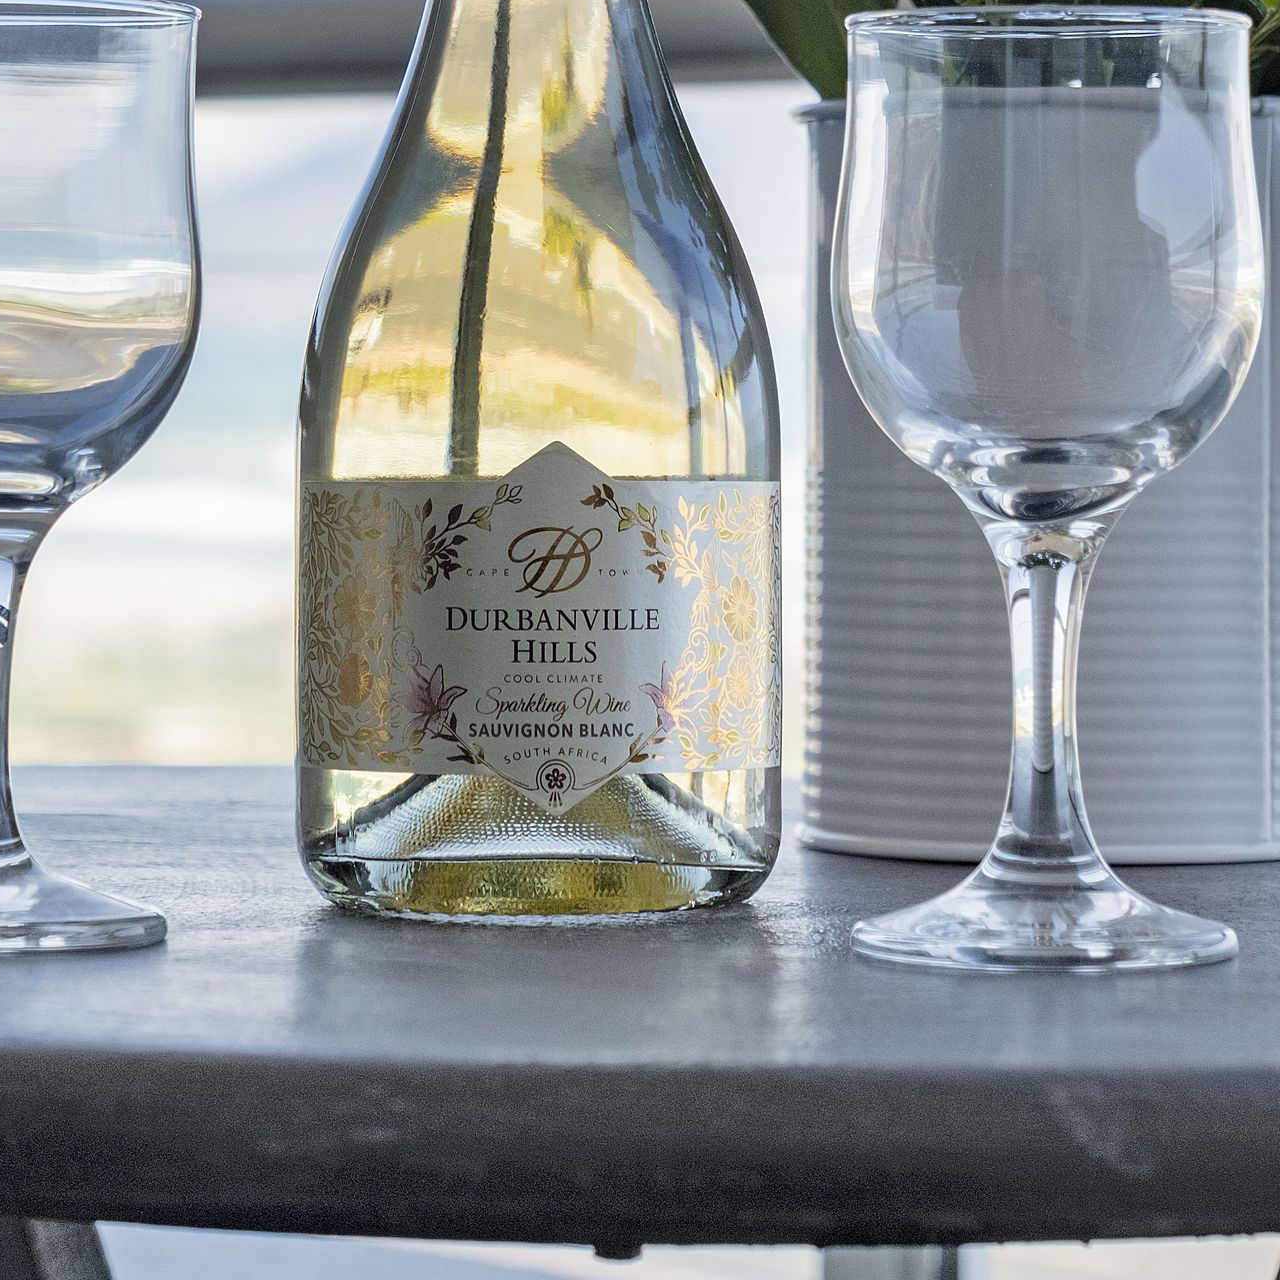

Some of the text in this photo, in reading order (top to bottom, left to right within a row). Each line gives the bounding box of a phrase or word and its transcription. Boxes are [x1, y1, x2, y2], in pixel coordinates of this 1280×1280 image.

[466, 567, 510, 578] CAPE
[445, 606, 660, 631] DURBANVILLE
[511, 639, 598, 664] HILLS
[503, 673, 604, 684] COOL CLIMATE
[475, 686, 632, 722] Sparkling Wine
[468, 722, 634, 738] SAUVIGNON BLANC
[503, 747, 608, 765] SOUTH AFRICA
